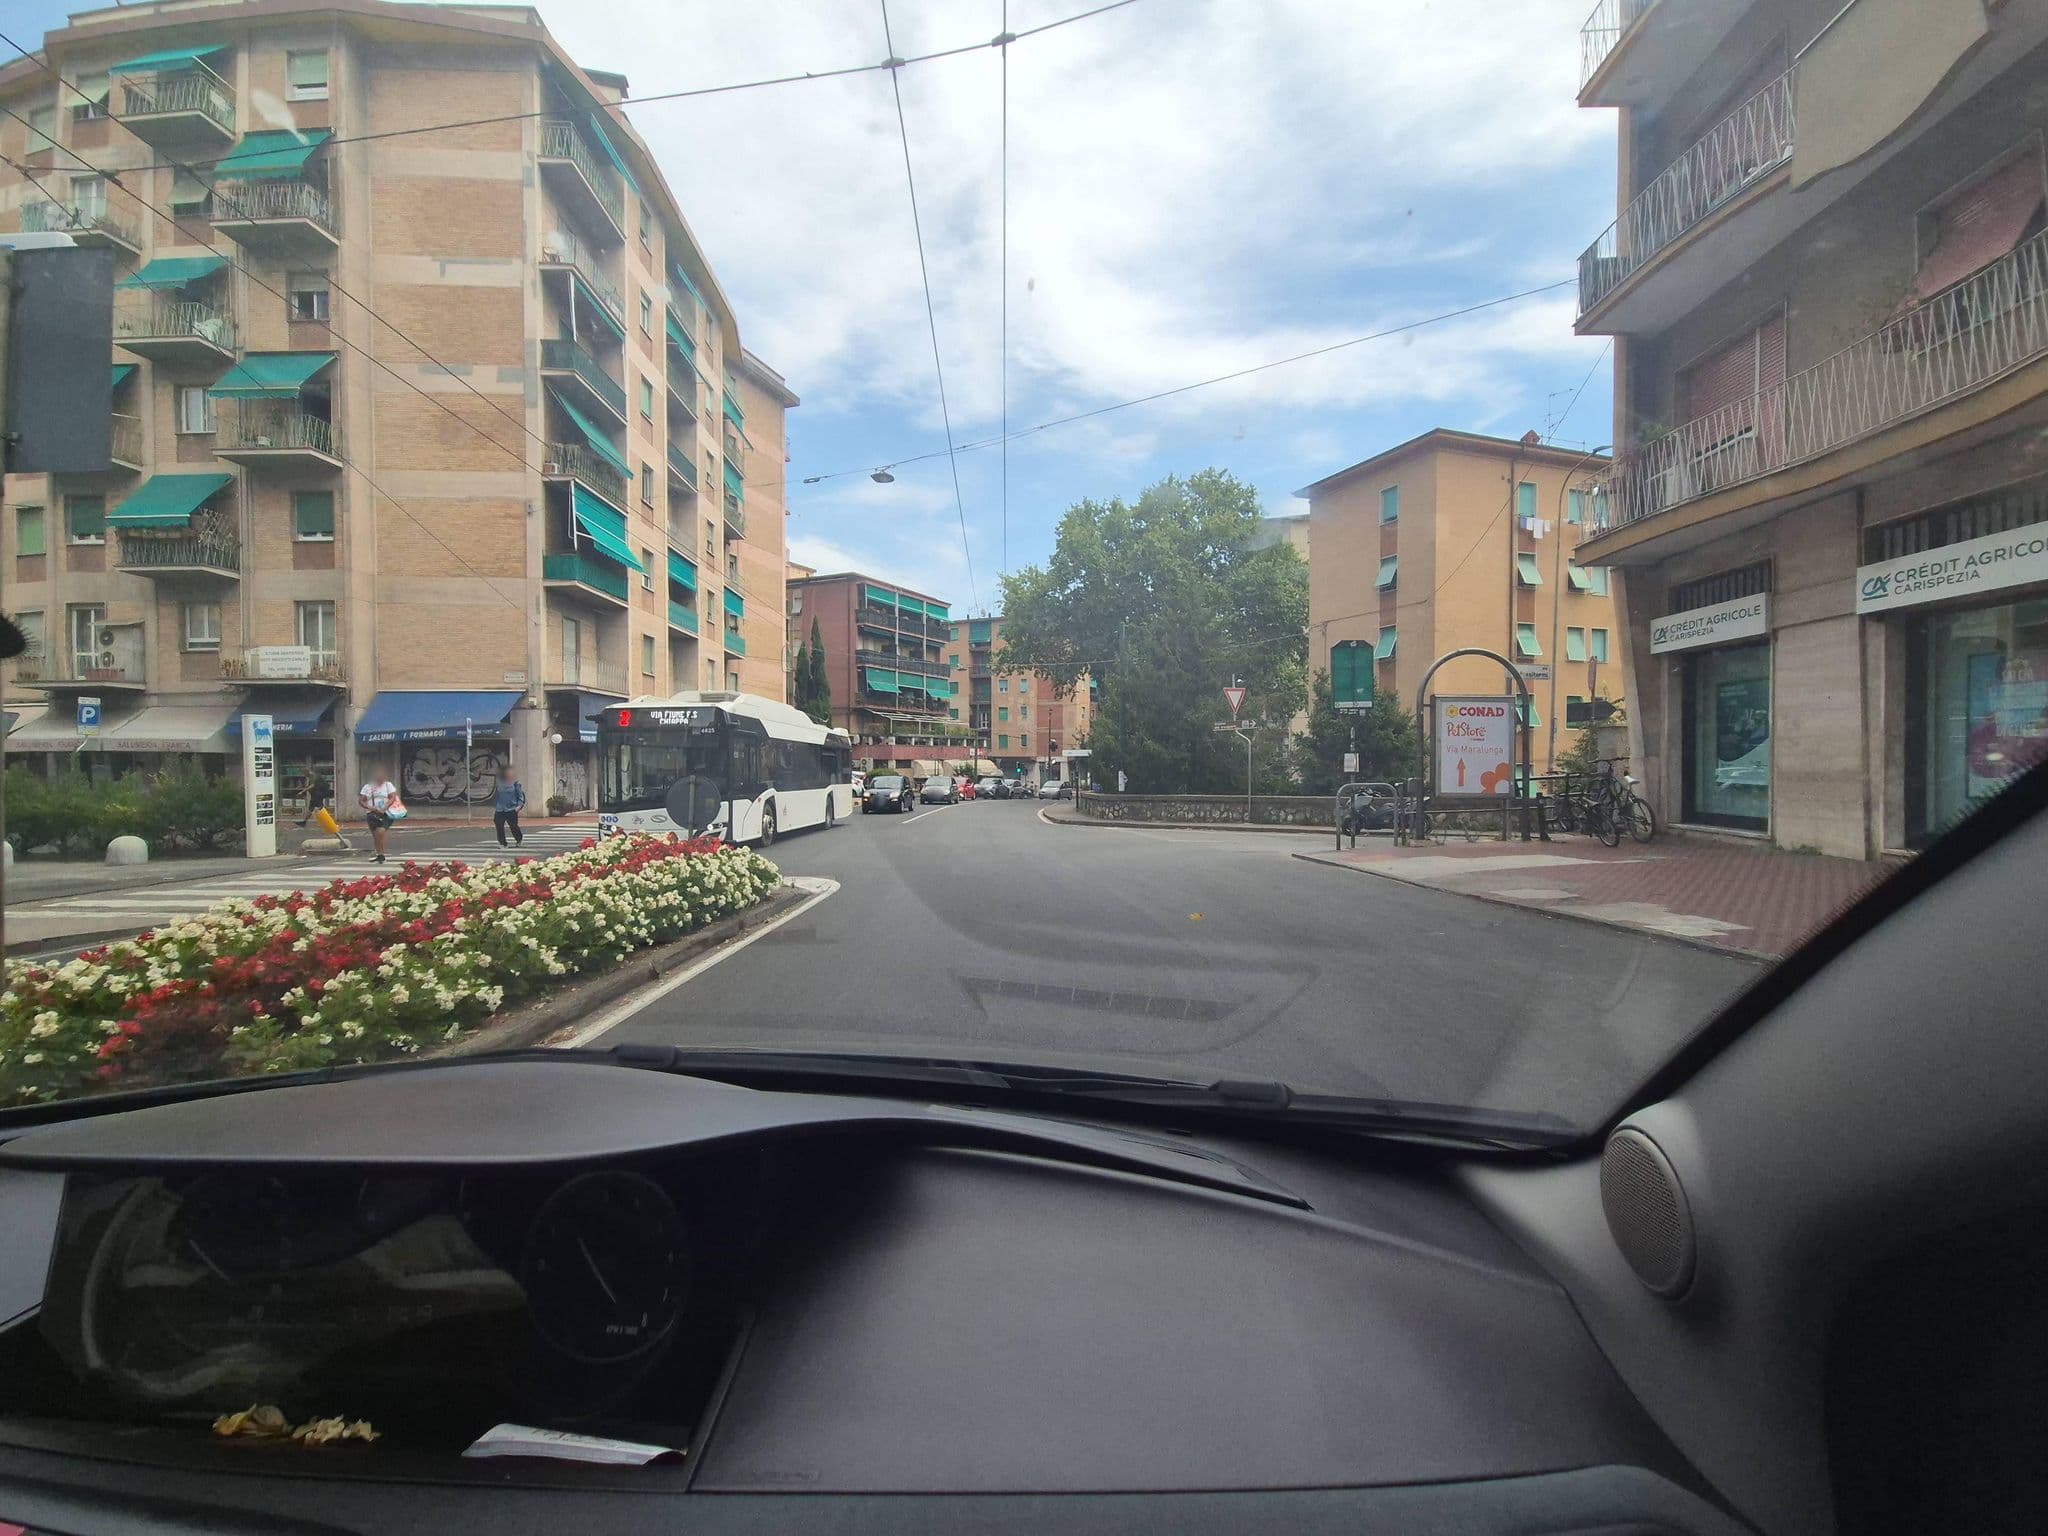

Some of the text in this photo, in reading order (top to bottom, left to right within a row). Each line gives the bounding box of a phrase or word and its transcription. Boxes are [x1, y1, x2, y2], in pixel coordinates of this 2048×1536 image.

[1894, 558, 1960, 583] CRÉDIT
[1964, 539, 2048, 569] AGRICO
[1894, 570, 1981, 595] CARISPEZIA
[1669, 617, 1704, 634] CRÉDIT
[1706, 605, 1761, 626] AGRICOLE
[1669, 627, 1714, 642] CARISPEZIA
[82, 706, 96, 723] P
[618, 710, 631, 727] 2
[650, 710, 662, 719] VIA
[664, 710, 685, 719] FIUME
[1459, 707, 1505, 717] CONAD
[368, 733, 395, 741] SALUMI
[410, 730, 446, 738] FORMAGGI
[1461, 746, 1504, 756] Maralunga
